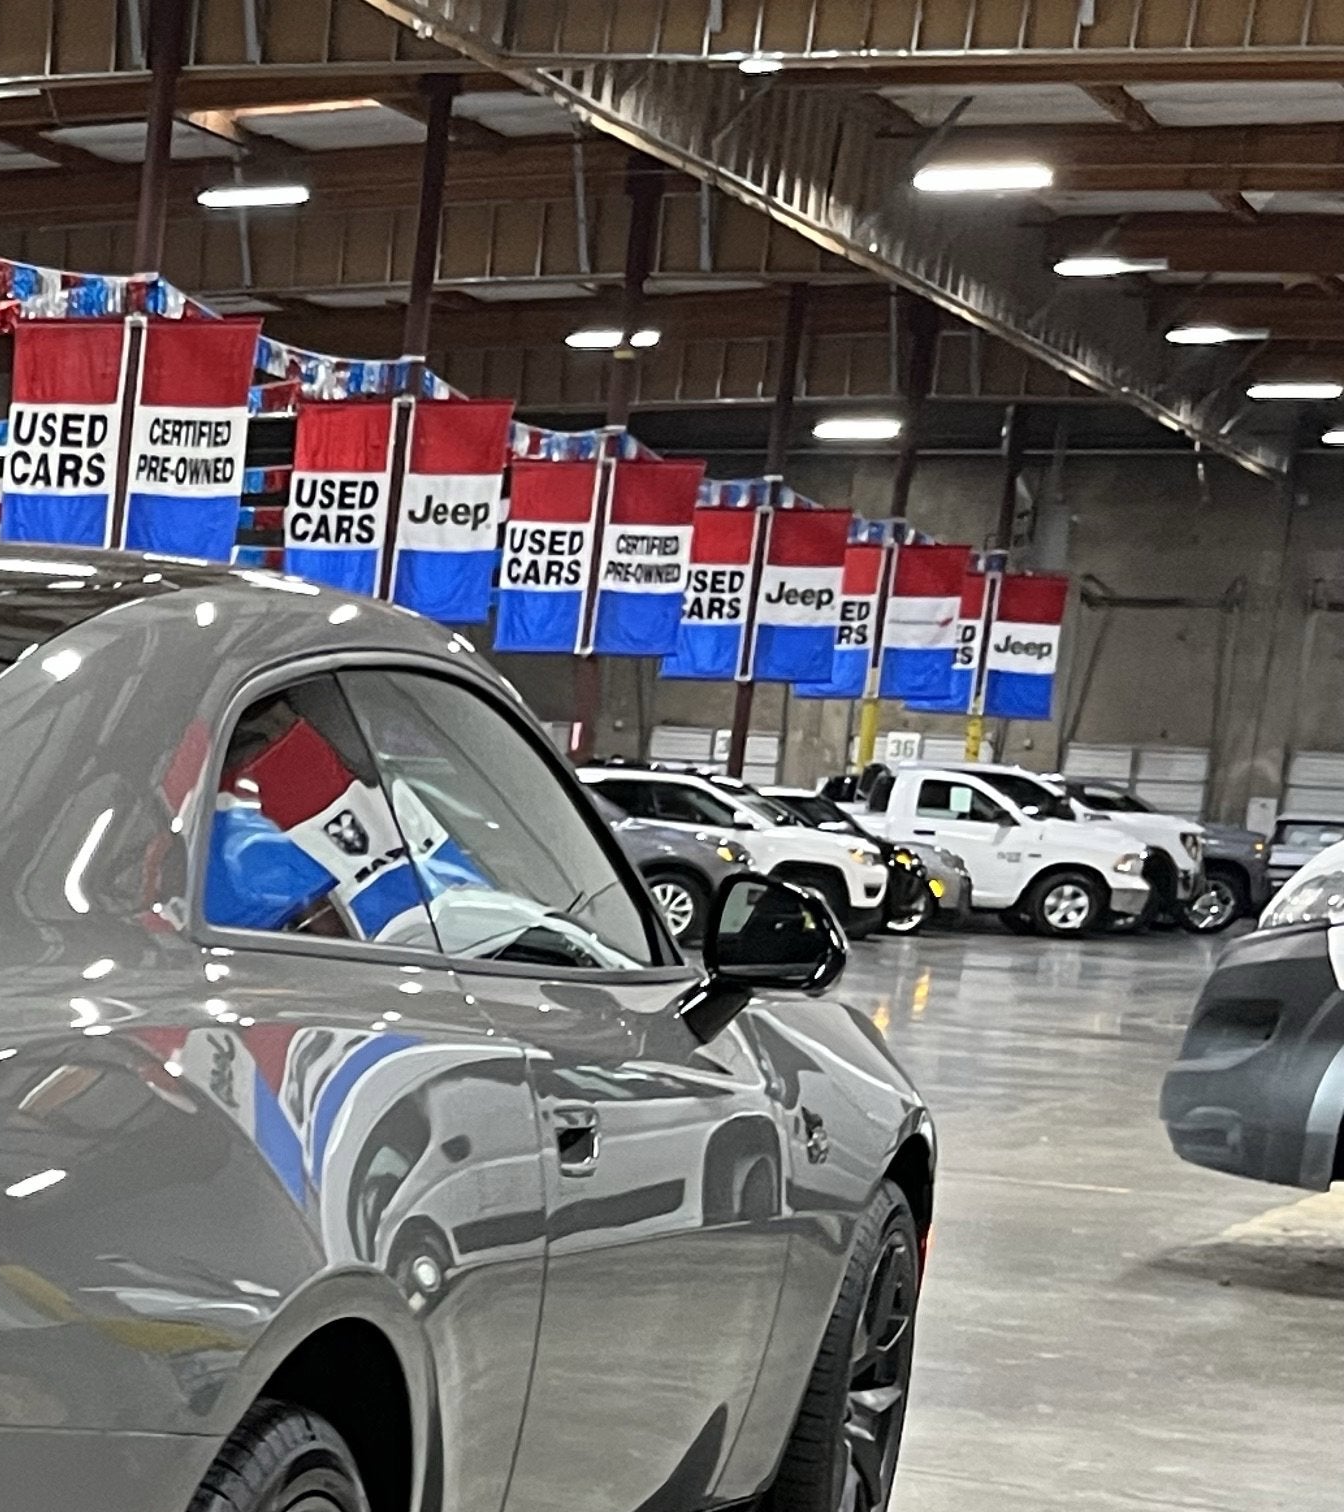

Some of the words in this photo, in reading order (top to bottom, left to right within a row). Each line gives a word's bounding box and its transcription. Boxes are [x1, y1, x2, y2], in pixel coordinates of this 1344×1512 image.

[14, 411, 108, 448] USED
[149, 418, 232, 447] CERTIFIED
[10, 450, 106, 488] CARS
[136, 453, 234, 484] PRE-OWNED
[295, 478, 379, 509] USED
[408, 495, 490, 531] Jeep
[290, 513, 376, 544] CARS
[509, 528, 584, 556] USED
[616, 535, 680, 557] CERTIFIED
[507, 558, 582, 585] CARS
[603, 561, 681, 584] PRE-OWNED
[686, 597, 742, 620] ARS
[765, 581, 834, 610] Jeep
[994, 635, 1053, 660] Jeep
[889, 739, 916, 758] 36
